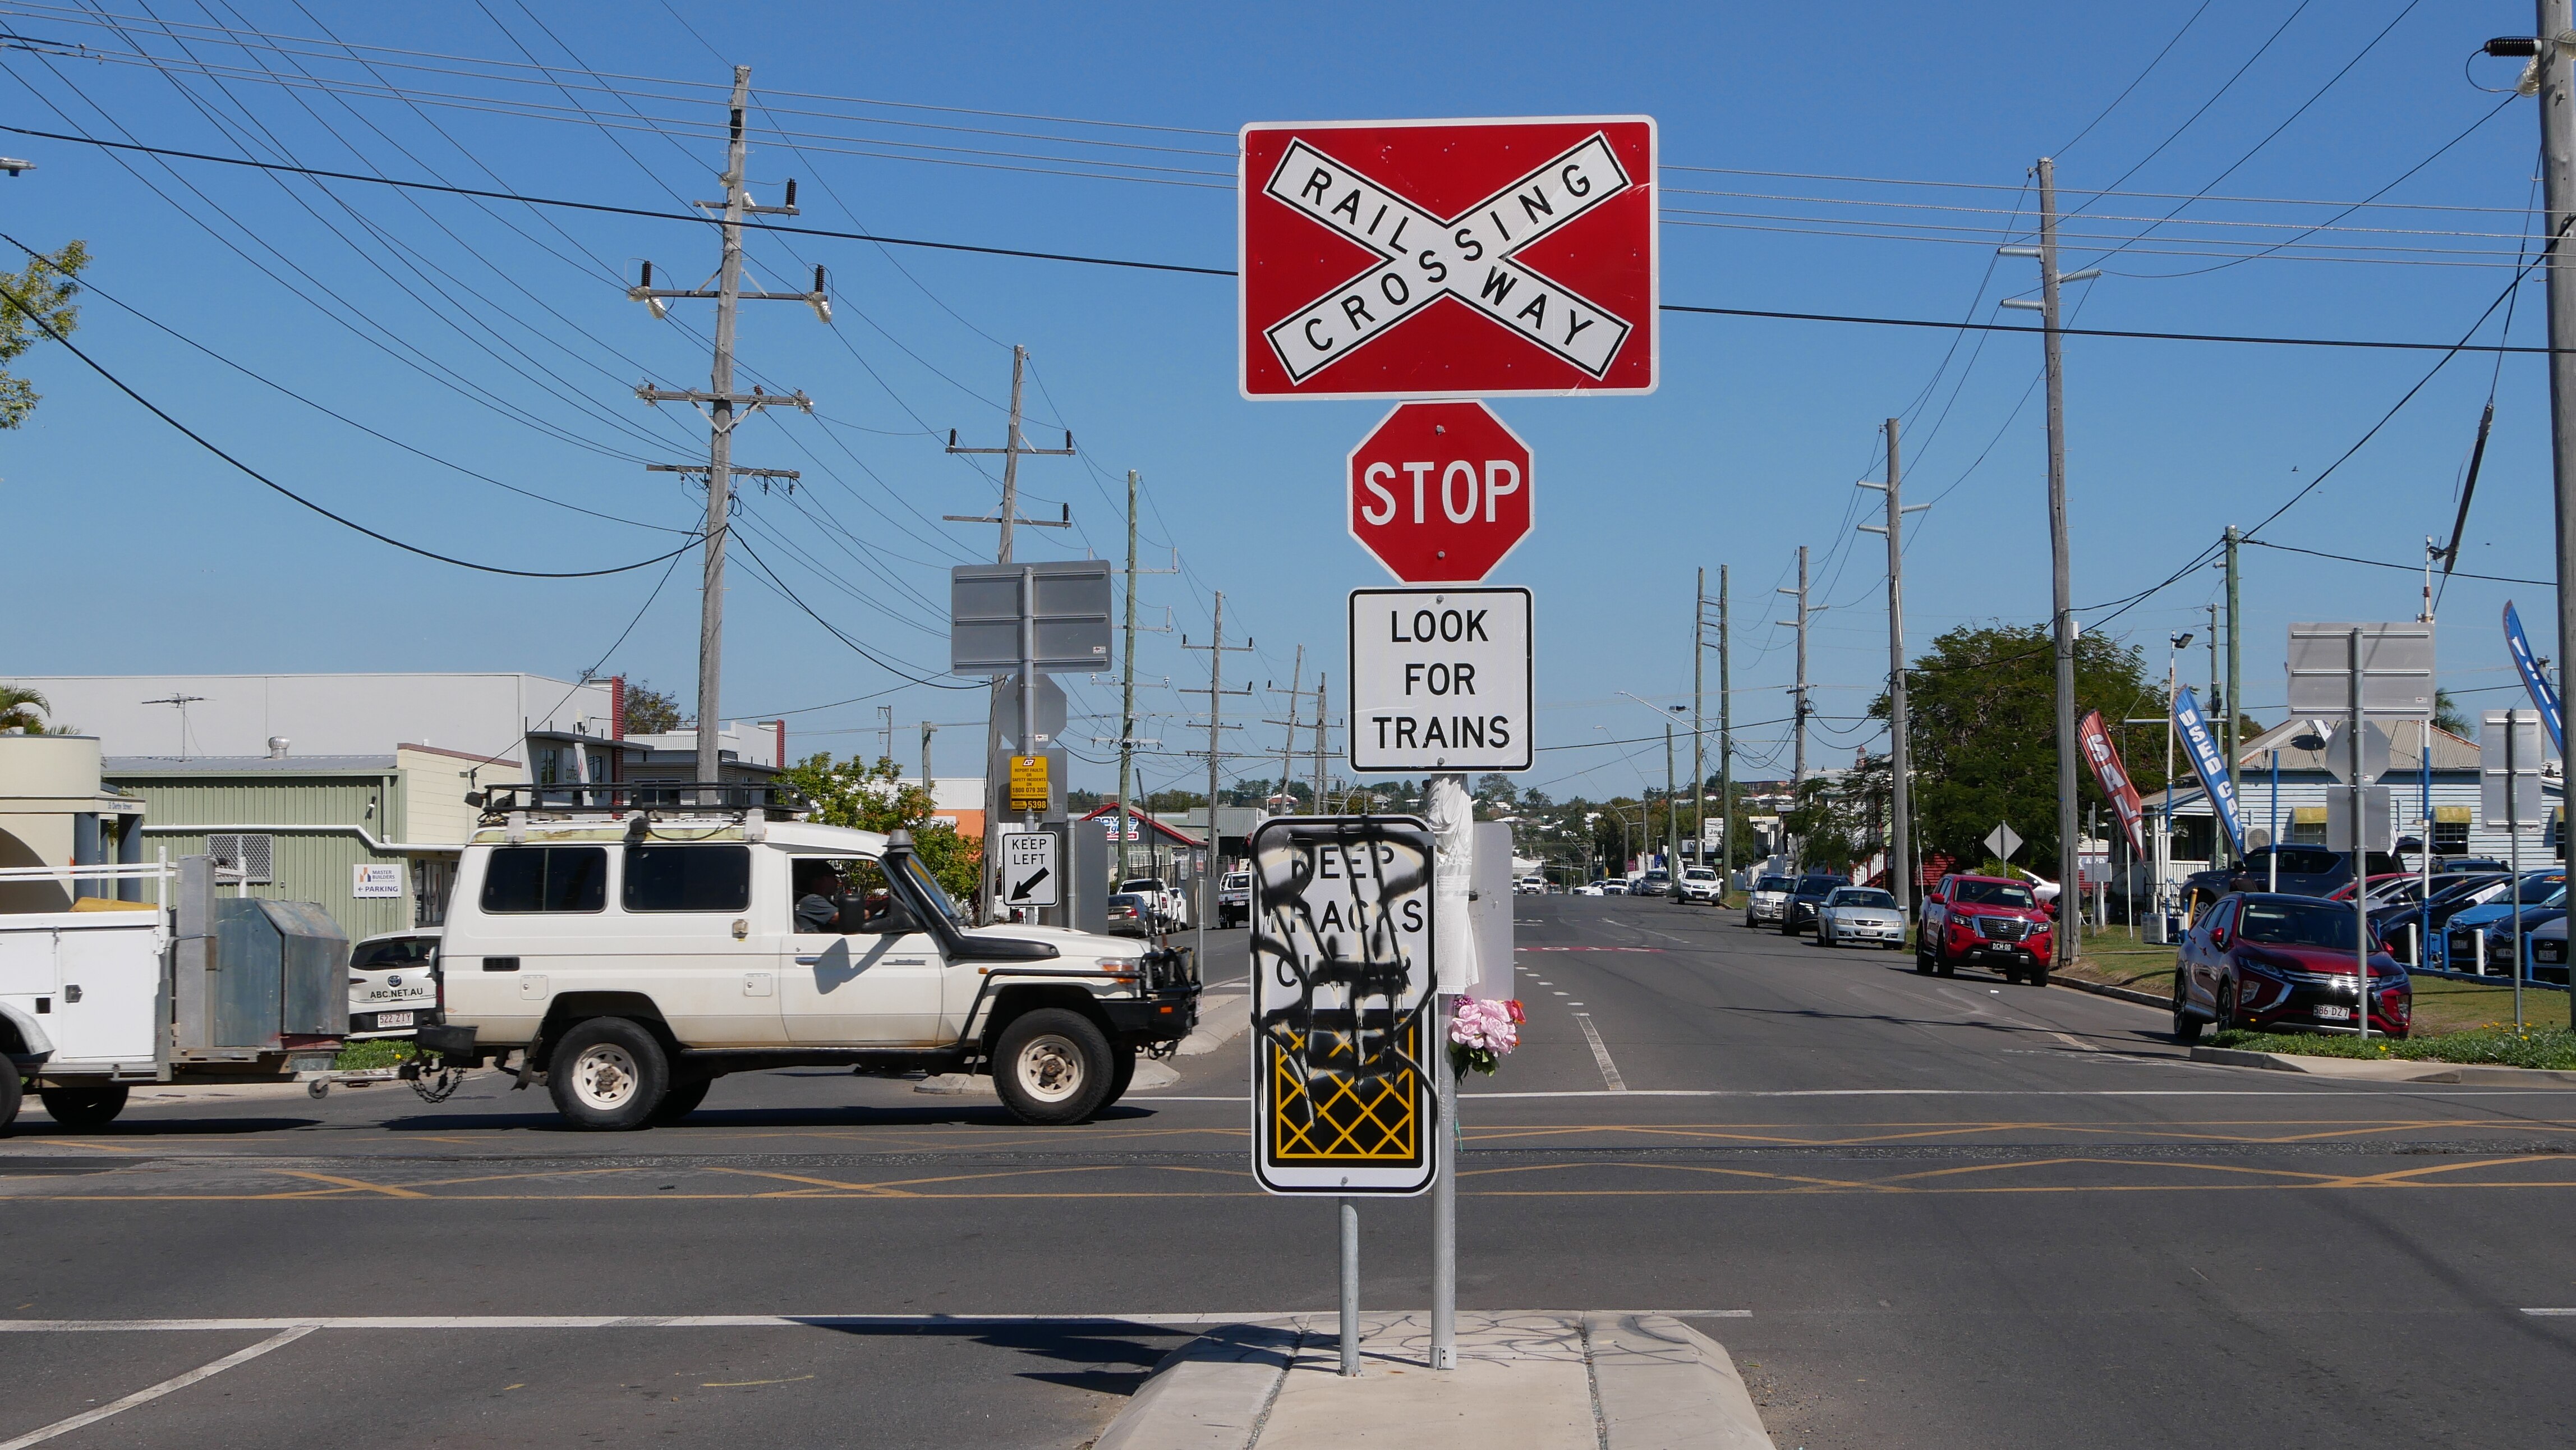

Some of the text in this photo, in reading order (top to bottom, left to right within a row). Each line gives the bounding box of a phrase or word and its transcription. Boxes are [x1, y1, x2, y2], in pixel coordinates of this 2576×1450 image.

[1301, 167, 1594, 346] RAIL WAY
[1304, 163, 1591, 352] CROSSING
[1361, 460, 1521, 526] STOP
[1391, 609, 1489, 643] LOOK
[1405, 662, 1476, 696] FOR
[1372, 715, 1510, 749] TRAINS
[2178, 709, 2222, 776] USED
[1028, 800, 1046, 809] 5398
[1012, 838, 1047, 850] KEEP
[1013, 854, 1046, 865] LEFT
[370, 988, 423, 998] ABC.NET.AU
